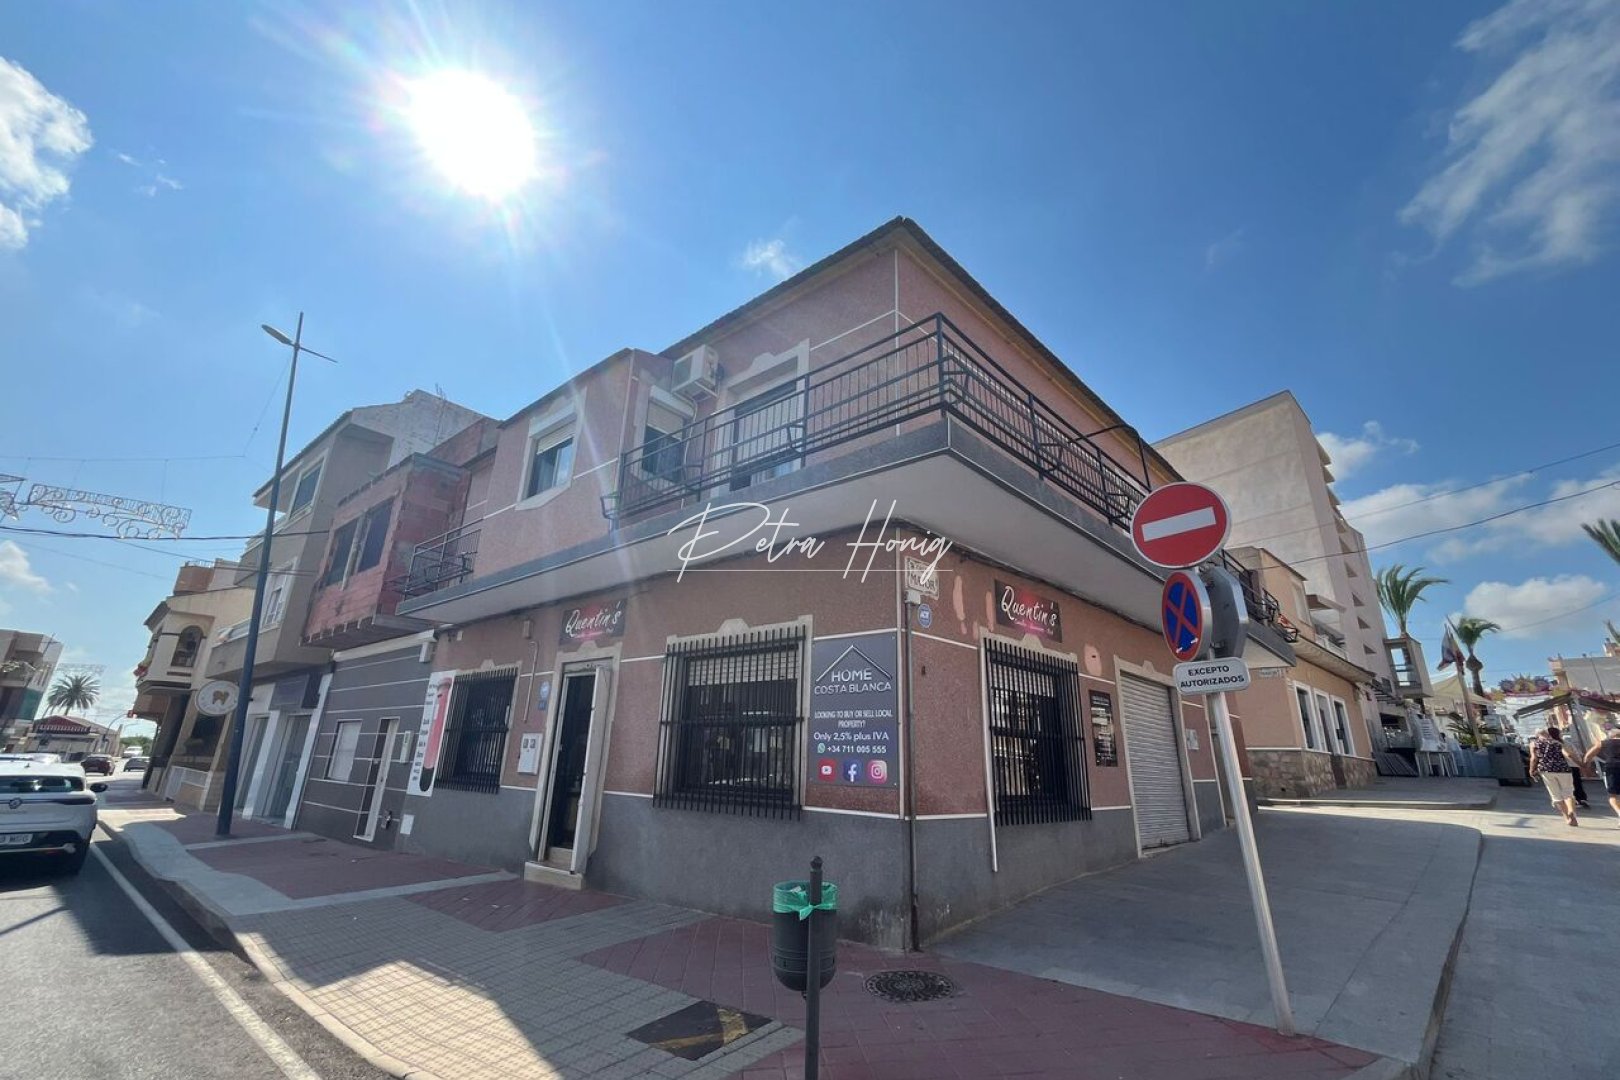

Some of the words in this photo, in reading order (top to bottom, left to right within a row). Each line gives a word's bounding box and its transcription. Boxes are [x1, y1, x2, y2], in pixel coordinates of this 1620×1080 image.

[1001, 585, 1058, 627] Quentin's
[565, 600, 622, 638] Quentin's
[831, 668, 873, 682] HOME
[1188, 665, 1230, 677] EXCEPTO
[814, 684, 847, 695] COSTA
[849, 681, 892, 693] BLANCA
[1180, 675, 1245, 688] AUTORIZADOS
[813, 731, 831, 742] Only
[853, 732, 871, 742] plus
[872, 731, 889, 740] IVA
[827, 745, 840, 753] +34
[842, 745, 854, 753] 711
